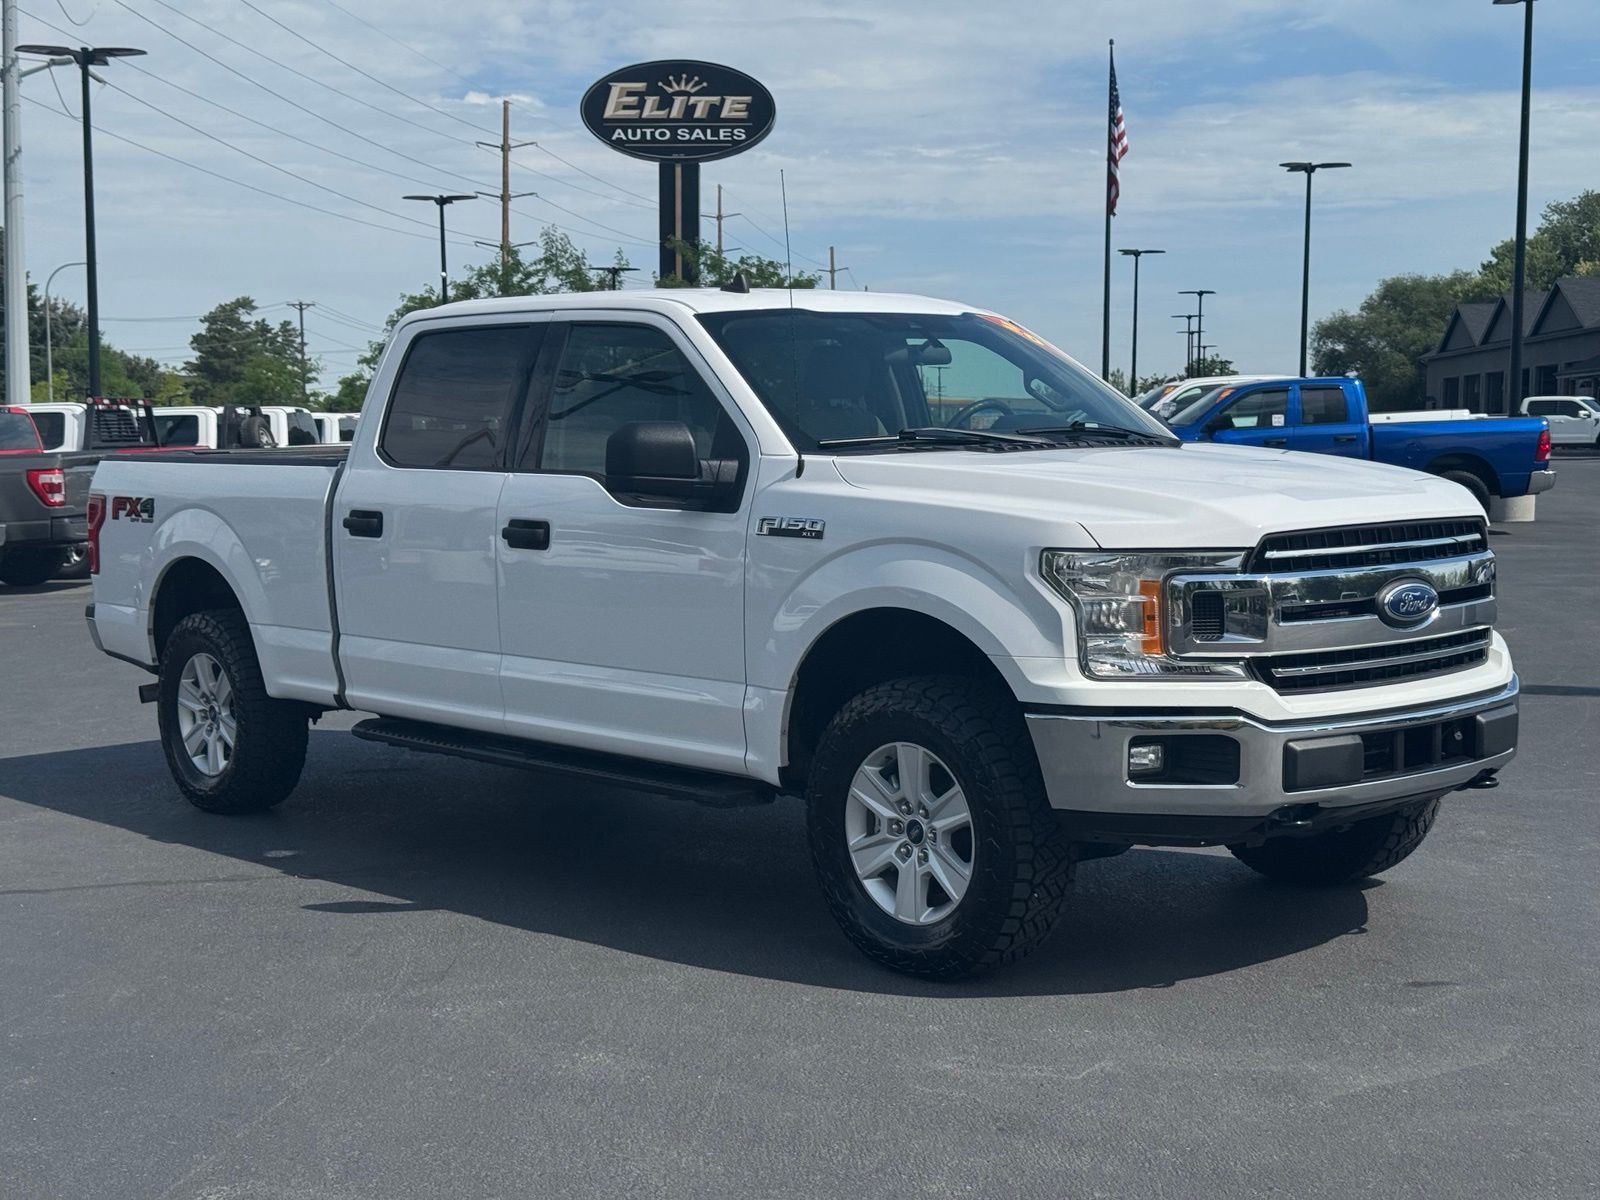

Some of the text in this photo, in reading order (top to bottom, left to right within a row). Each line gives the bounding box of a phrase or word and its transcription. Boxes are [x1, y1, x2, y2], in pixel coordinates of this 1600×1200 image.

[603, 82, 752, 119] ELITE
[612, 128, 746, 141] AUTO SALES
[112, 496, 155, 520] FX4
[1399, 591, 1429, 613] Ford
